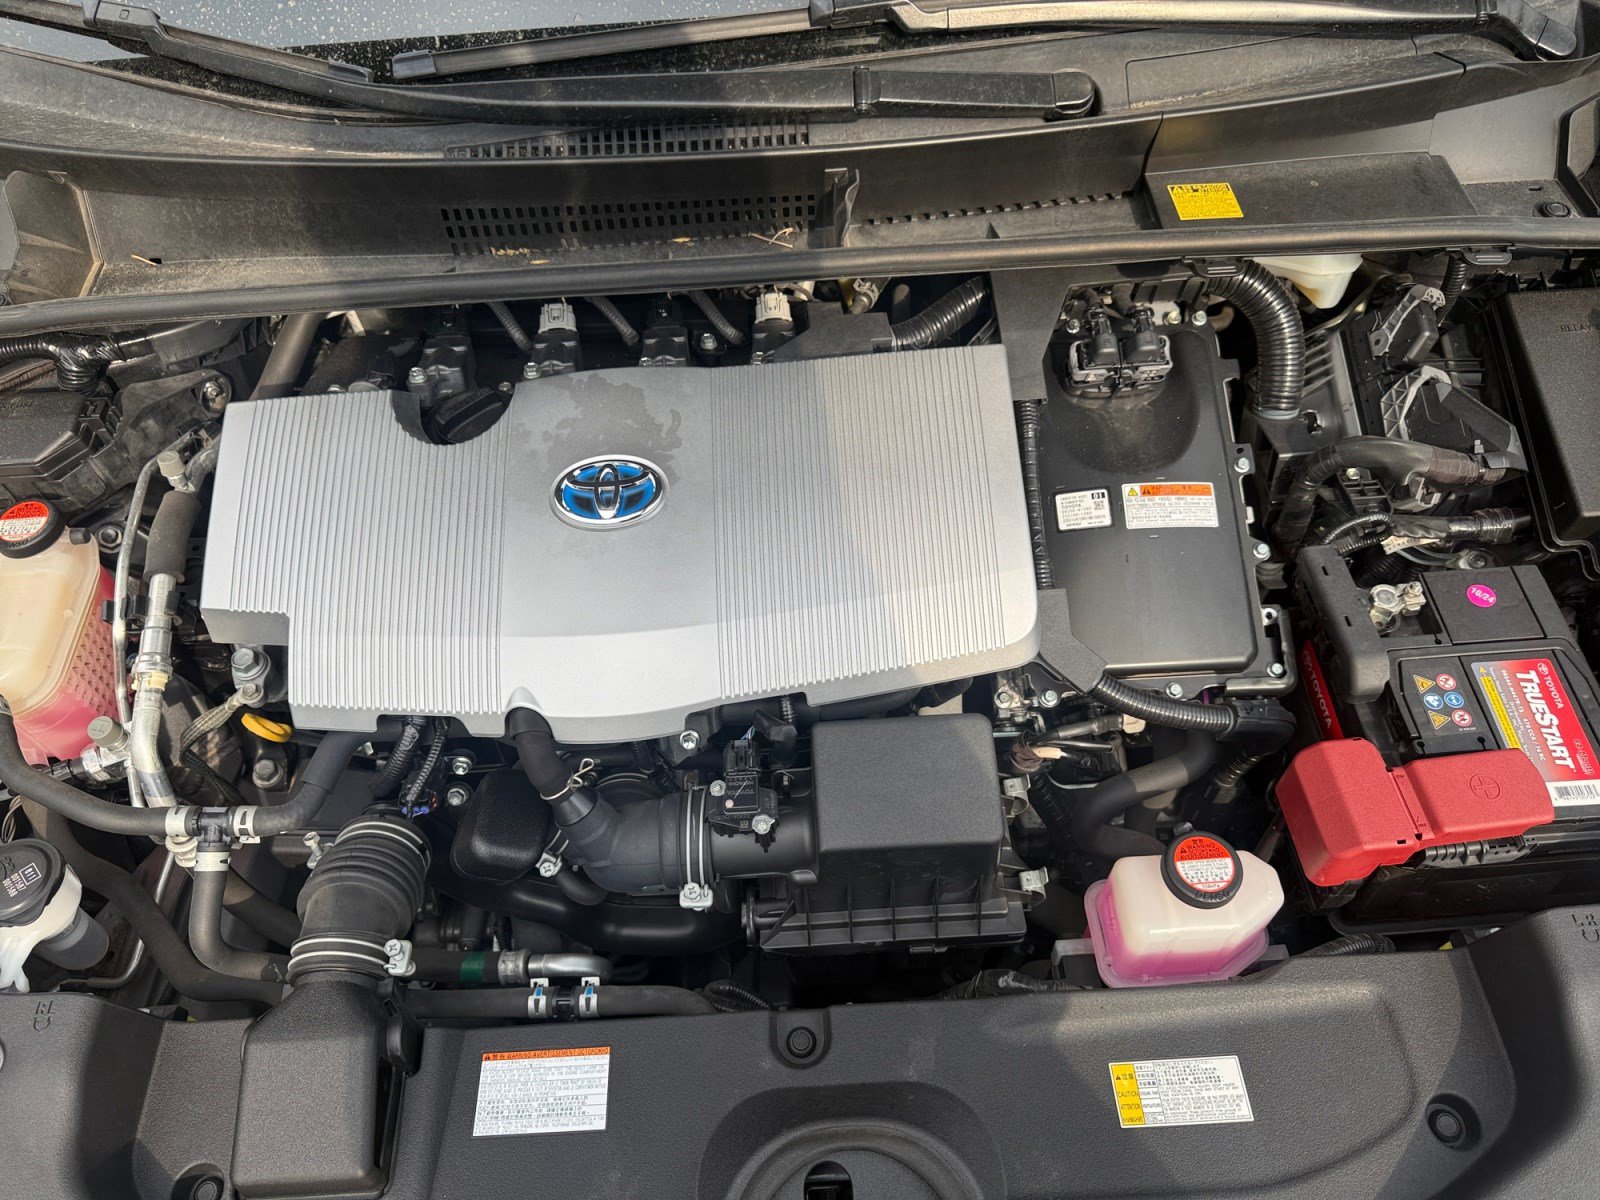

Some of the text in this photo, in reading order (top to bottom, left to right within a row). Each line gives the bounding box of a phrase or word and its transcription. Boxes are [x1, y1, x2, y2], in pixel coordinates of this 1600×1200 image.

[1471, 587, 1494, 603] 10/24
[1310, 670, 1332, 728] TOYOTA
[1545, 676, 1564, 709] TOYOTA
[1528, 730, 1536, 740] CCA
[507, 1051, 531, 1059] WARNING
[1118, 1090, 1139, 1098] CAUTION
